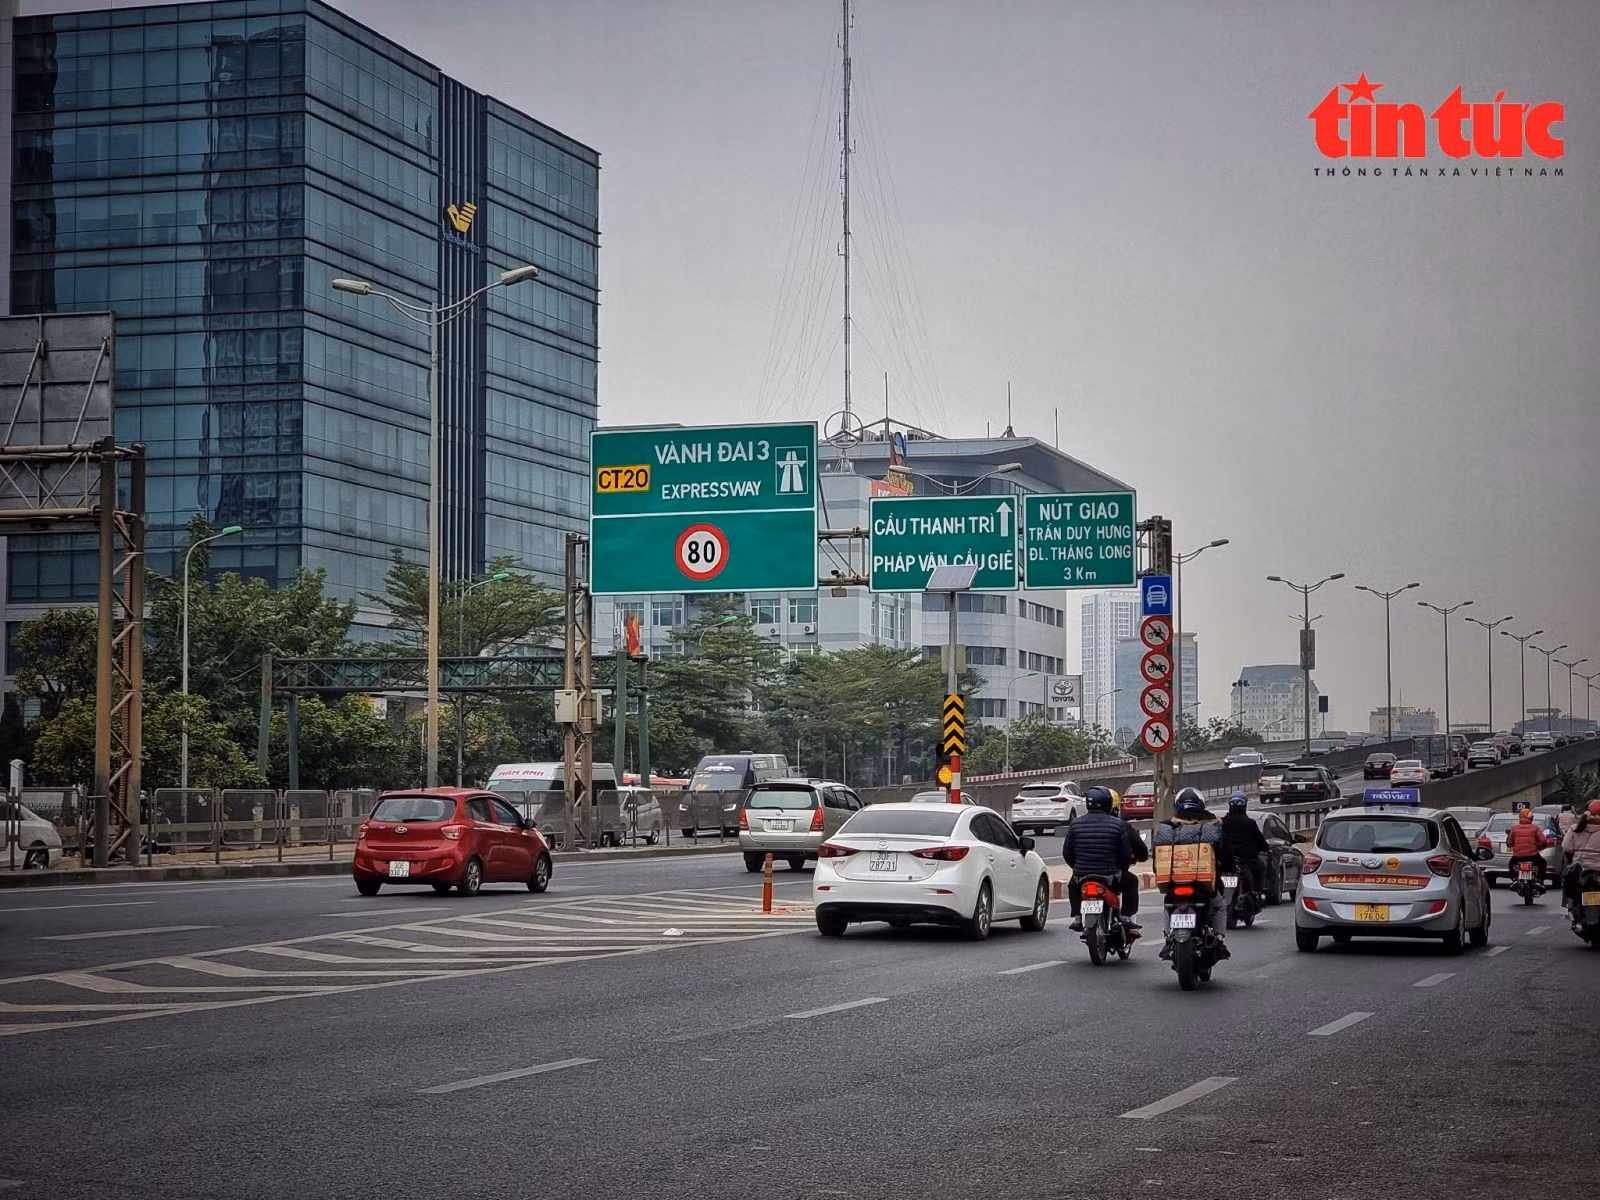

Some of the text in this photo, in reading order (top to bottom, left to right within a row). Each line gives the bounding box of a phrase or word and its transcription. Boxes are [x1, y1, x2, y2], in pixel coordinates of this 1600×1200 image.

[654, 440, 770, 465] VÀNH ĐAI 3
[661, 480, 762, 500] EXPRESSWAY
[1039, 499, 1119, 521] NÚT GIAO
[910, 516, 965, 535] THANH
[968, 513, 995, 534] TRÌ
[1028, 522, 1131, 541] TRẦN DUY HƯNG
[687, 540, 716, 564] 80
[873, 552, 916, 573] PHÁP
[1029, 547, 1049, 561] ĐL.
[1099, 545, 1132, 560] LONG
[1063, 567, 1097, 580] 3 Km
